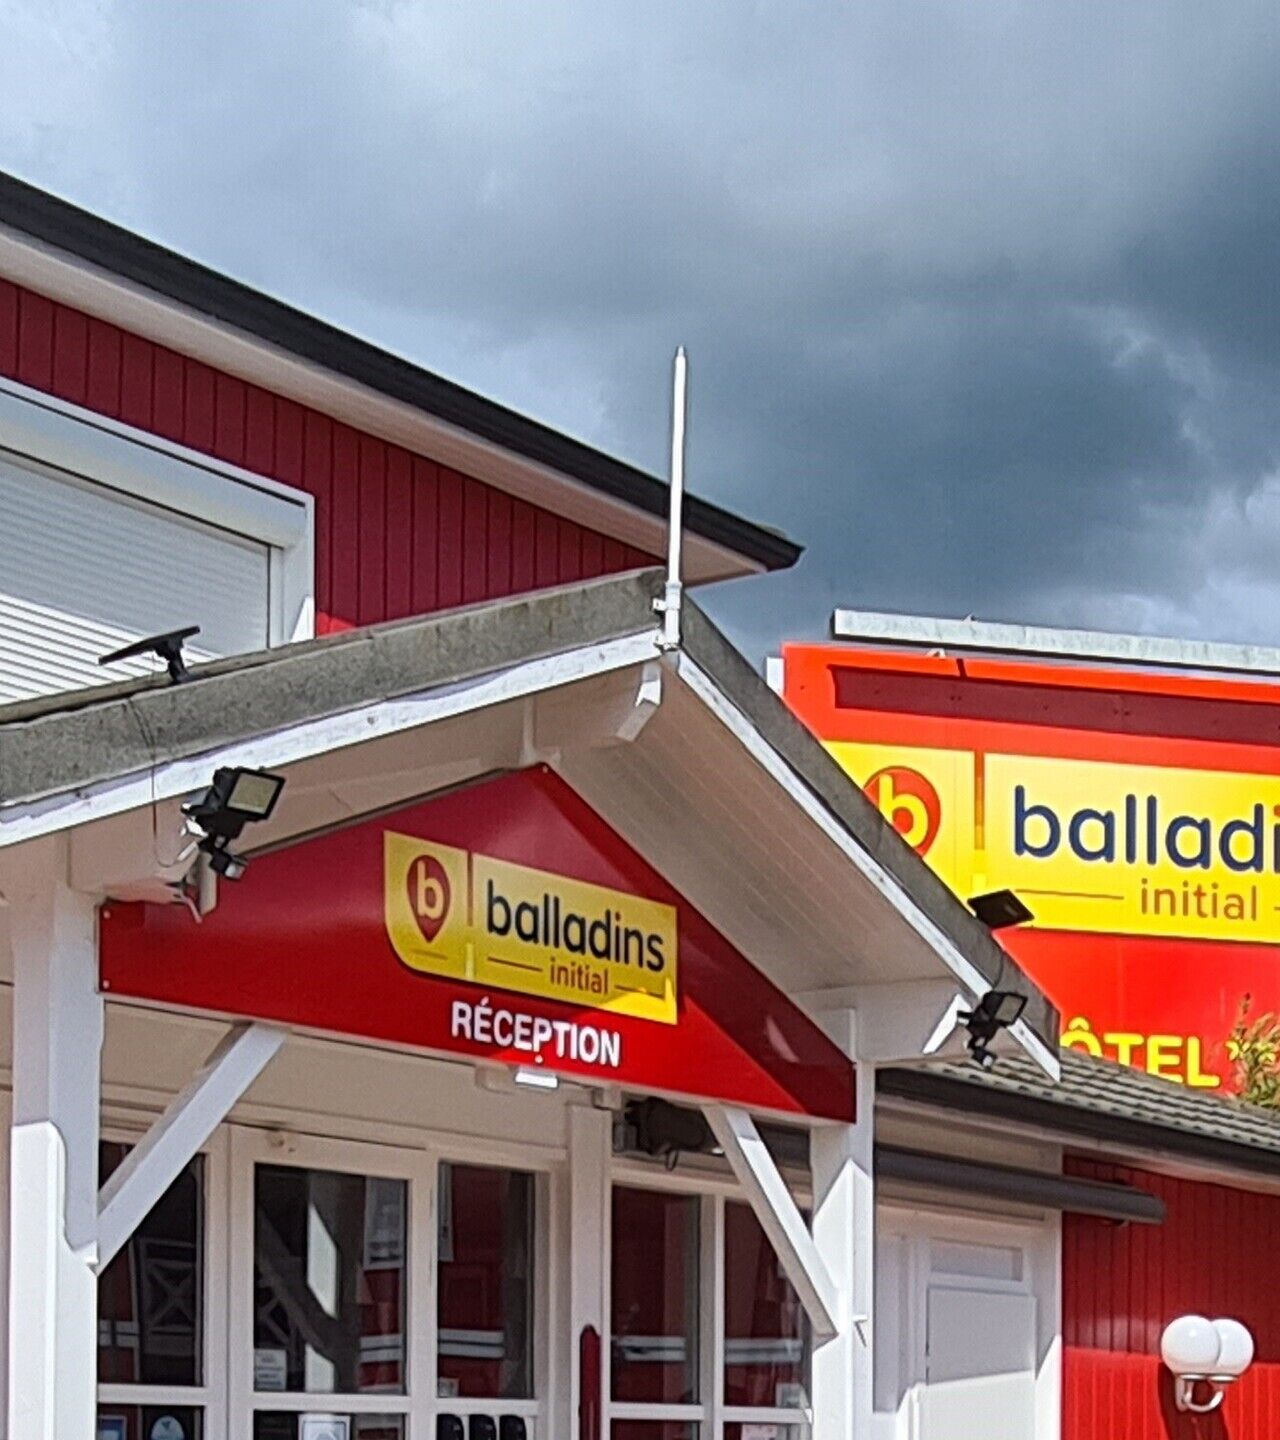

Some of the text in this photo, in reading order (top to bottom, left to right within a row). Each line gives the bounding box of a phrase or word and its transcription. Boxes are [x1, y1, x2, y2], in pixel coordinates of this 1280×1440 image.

[486, 878, 665, 972] balladins
[1140, 878, 1258, 922] initial
[549, 957, 609, 995] initial
[450, 996, 620, 1068] RÉCEPTION
